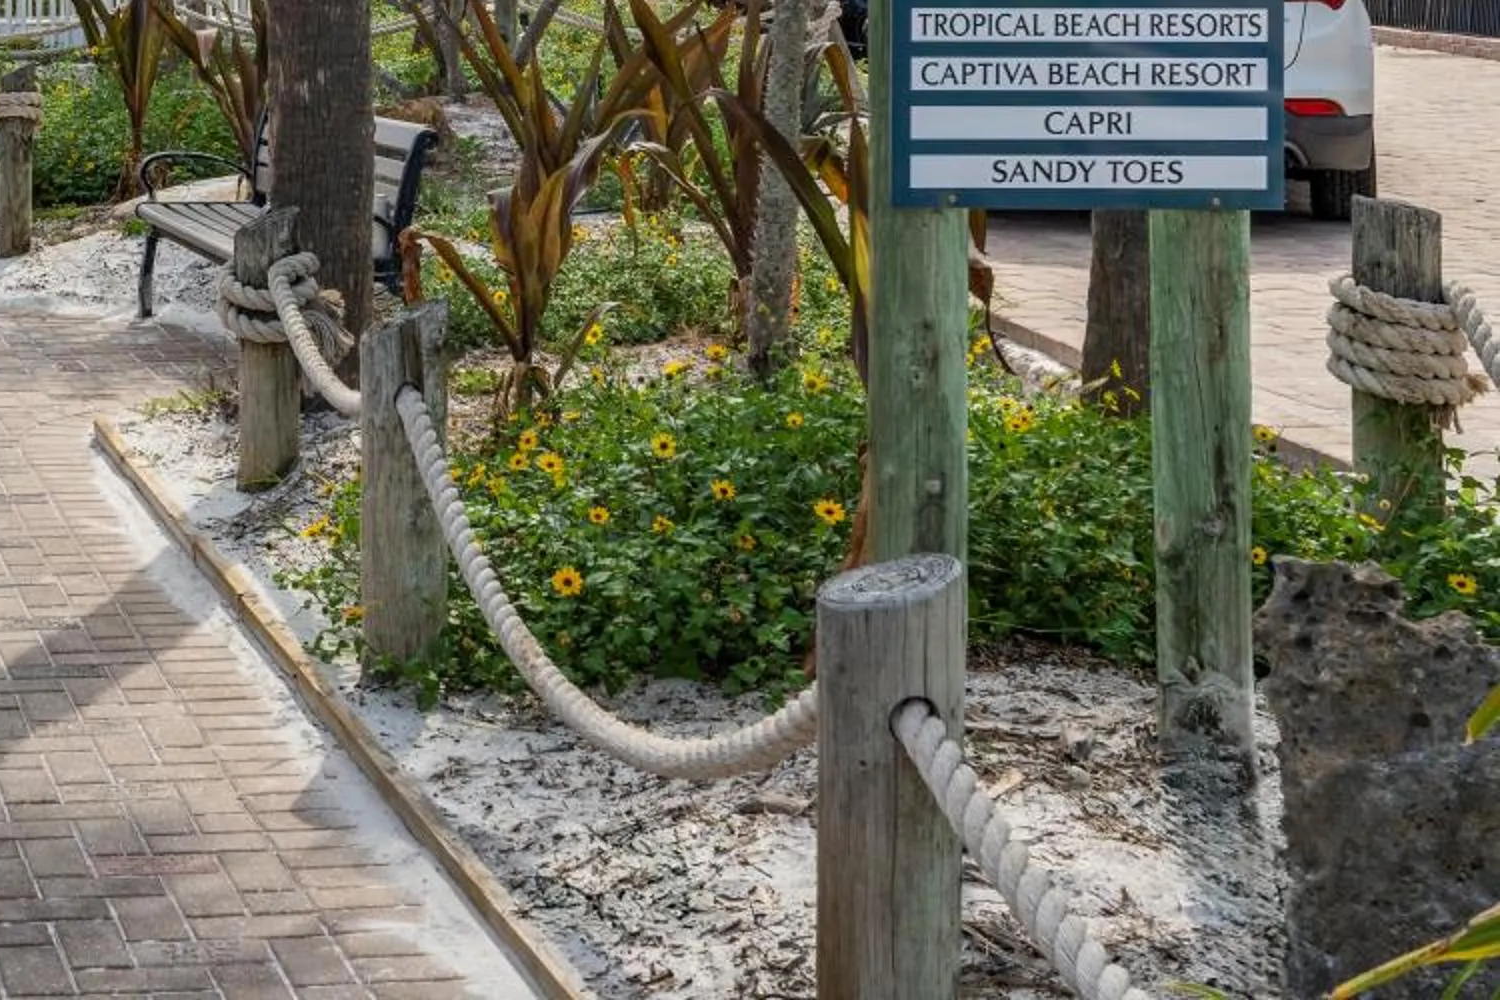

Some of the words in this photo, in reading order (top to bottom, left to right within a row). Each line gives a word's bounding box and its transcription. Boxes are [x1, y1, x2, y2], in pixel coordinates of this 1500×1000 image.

[917, 12, 1045, 37] TROPICAL
[1053, 13, 1141, 37] BEACH
[1149, 13, 1262, 38] RESORTS
[920, 61, 1039, 87] CAPTIVA
[1048, 61, 1141, 87] BEACH
[1151, 62, 1257, 87] RESORT
[1043, 110, 1132, 135] CAPRI
[991, 159, 1096, 184] SANDY
[1106, 159, 1184, 185] TOES
